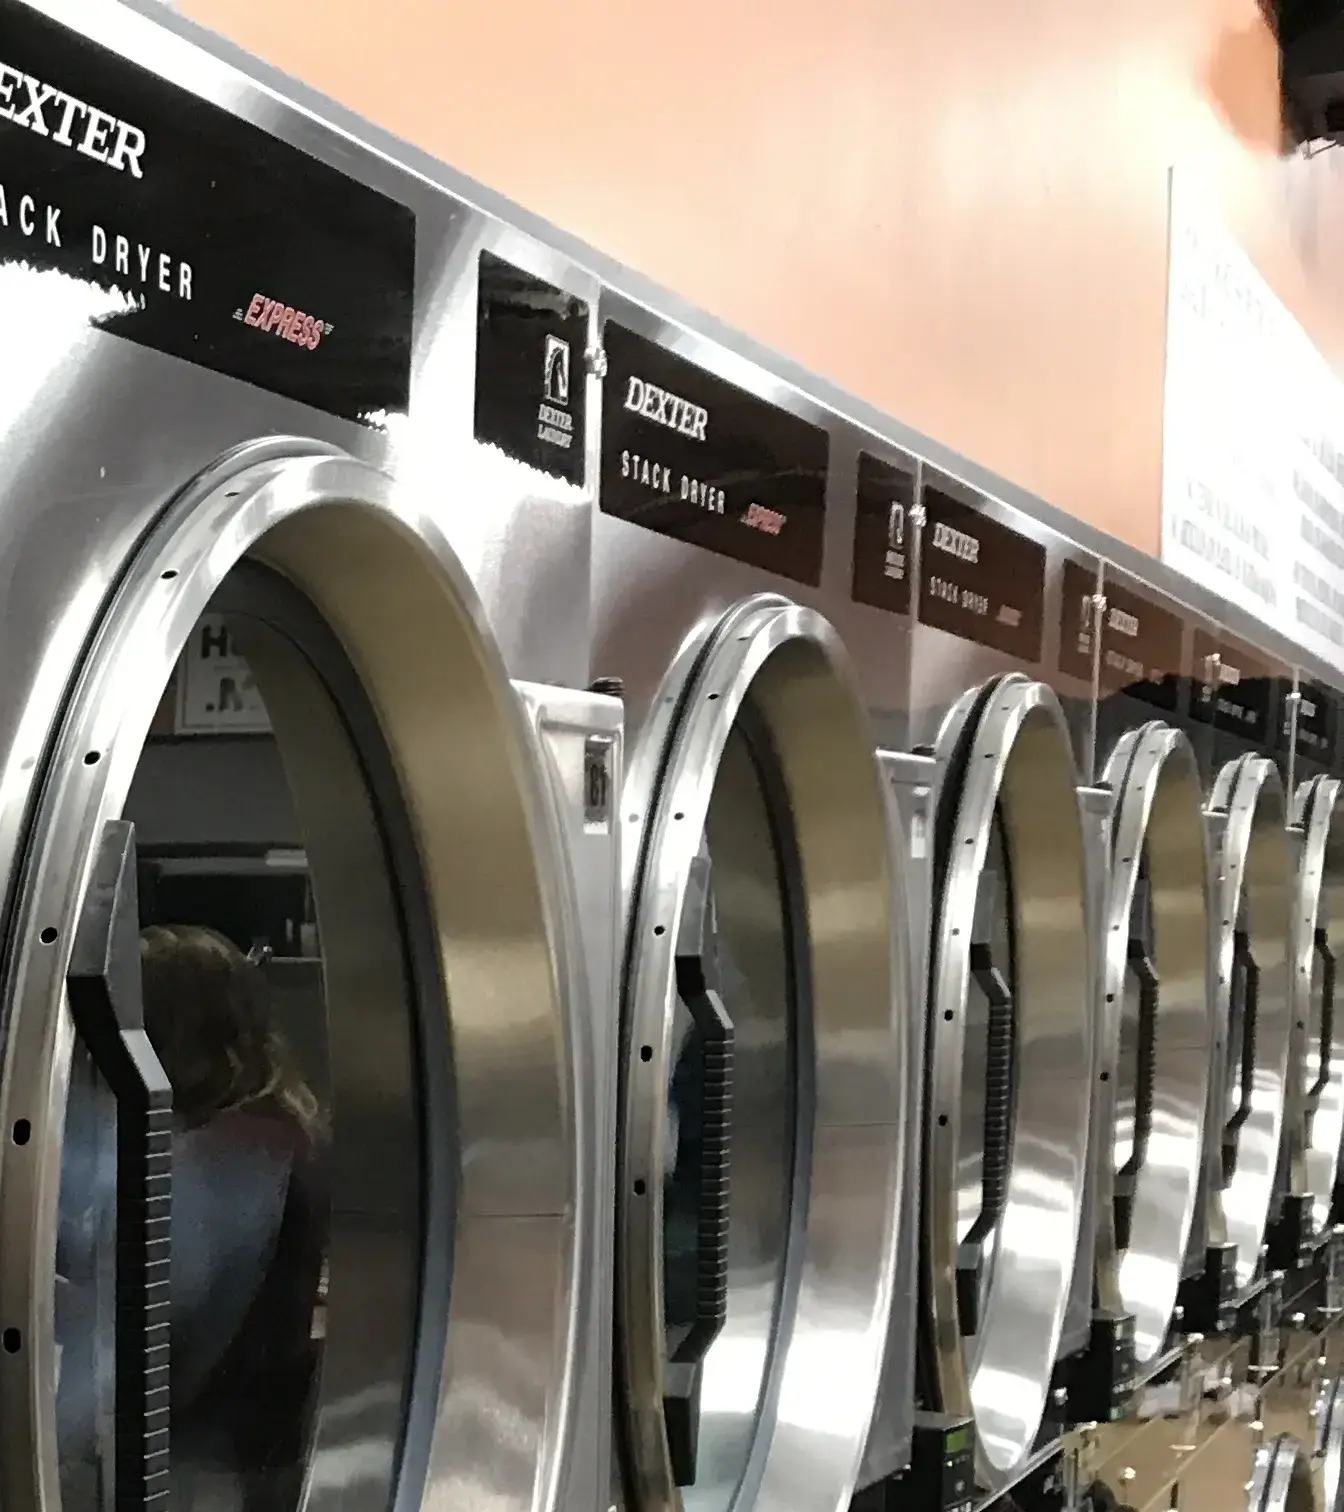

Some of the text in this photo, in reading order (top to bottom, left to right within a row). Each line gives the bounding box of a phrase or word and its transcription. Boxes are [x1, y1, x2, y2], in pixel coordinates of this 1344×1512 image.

[92, 223, 196, 301] DRYER
[244, 292, 325, 350] EXPRESS
[624, 376, 709, 442] DEXTER
[622, 450, 725, 514] STACK DRYER
